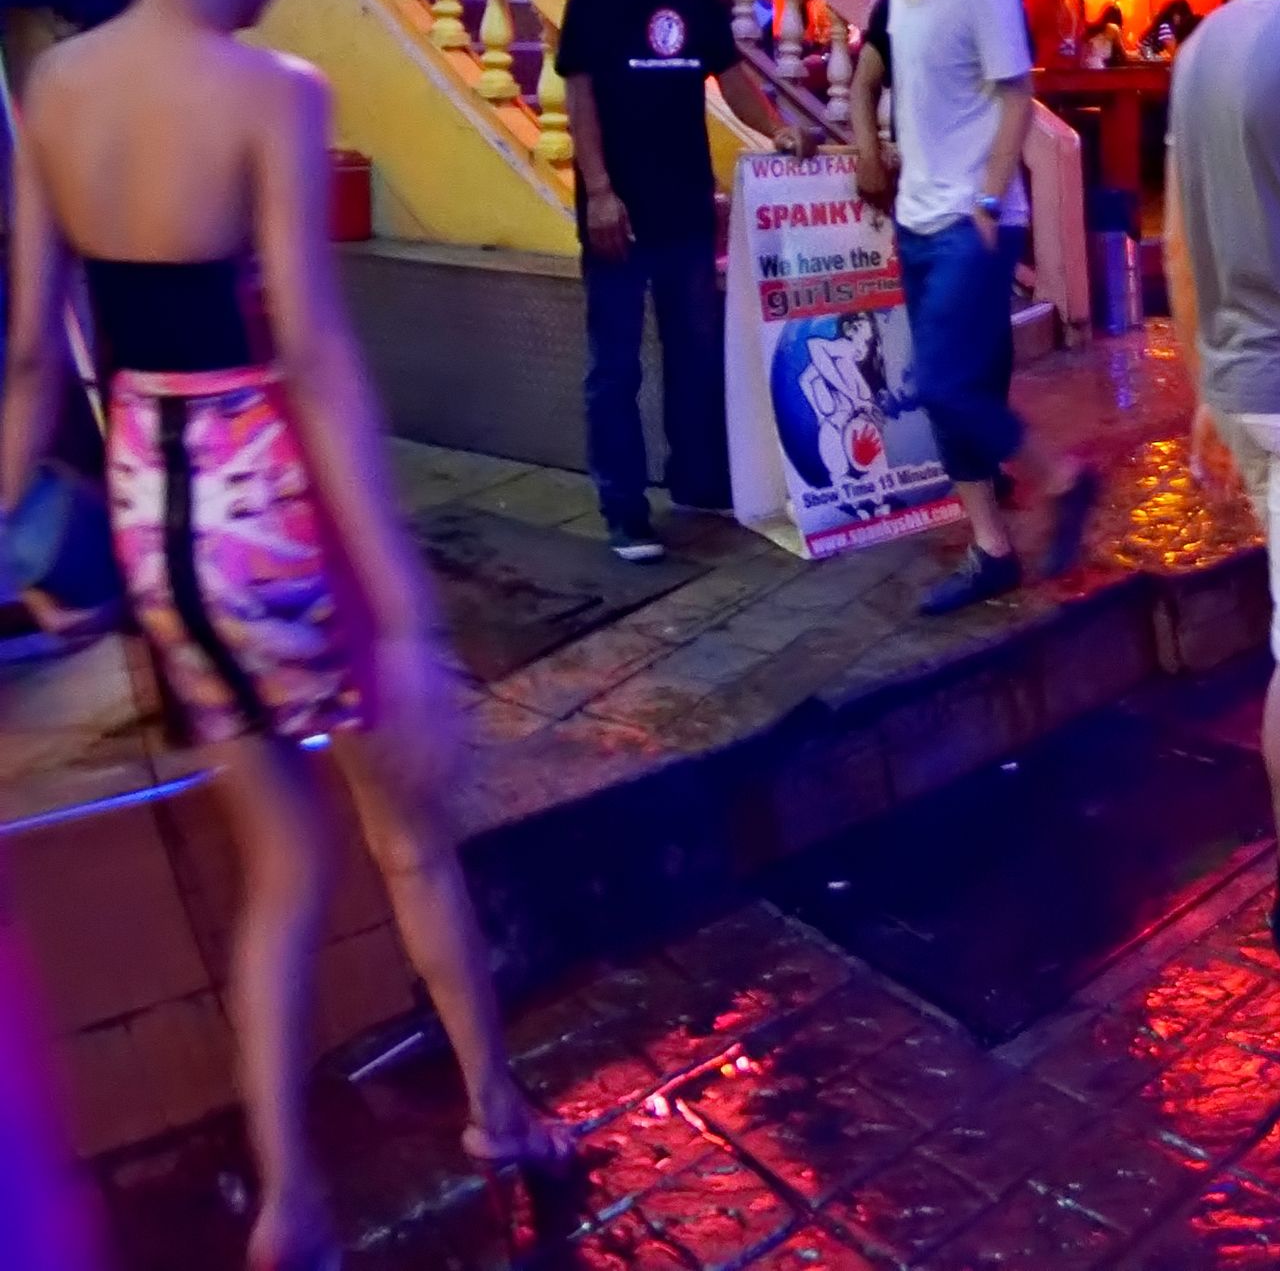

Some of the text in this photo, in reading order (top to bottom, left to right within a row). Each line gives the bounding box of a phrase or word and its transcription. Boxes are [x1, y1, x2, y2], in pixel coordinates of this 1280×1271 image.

[751, 157, 822, 178] WORLD
[760, 247, 882, 278] We have the
[766, 279, 855, 317] girls
[802, 490, 839, 509] Show
[841, 481, 876, 498] Time
